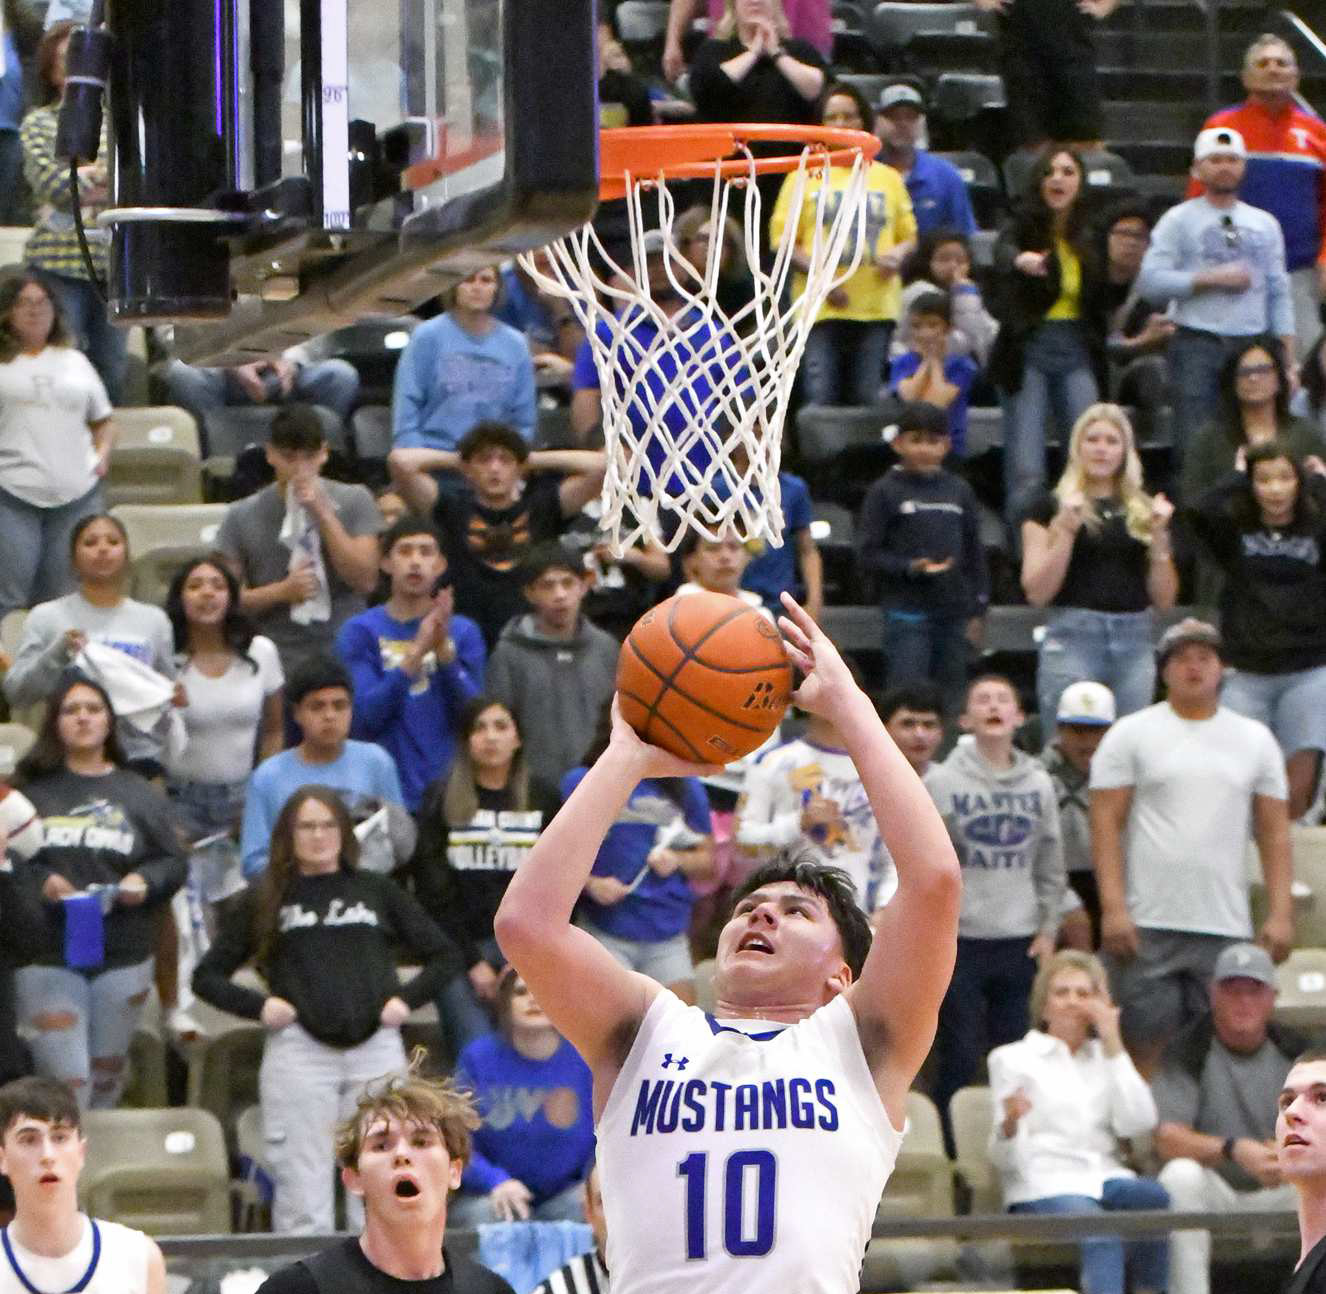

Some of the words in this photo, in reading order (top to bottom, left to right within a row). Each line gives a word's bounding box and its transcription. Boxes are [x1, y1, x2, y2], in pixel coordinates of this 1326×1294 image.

[279, 903, 319, 932] The
[322, 898, 378, 927] Lake
[630, 1078, 839, 1137] MUSTANGS
[675, 1148, 778, 1262] 10
